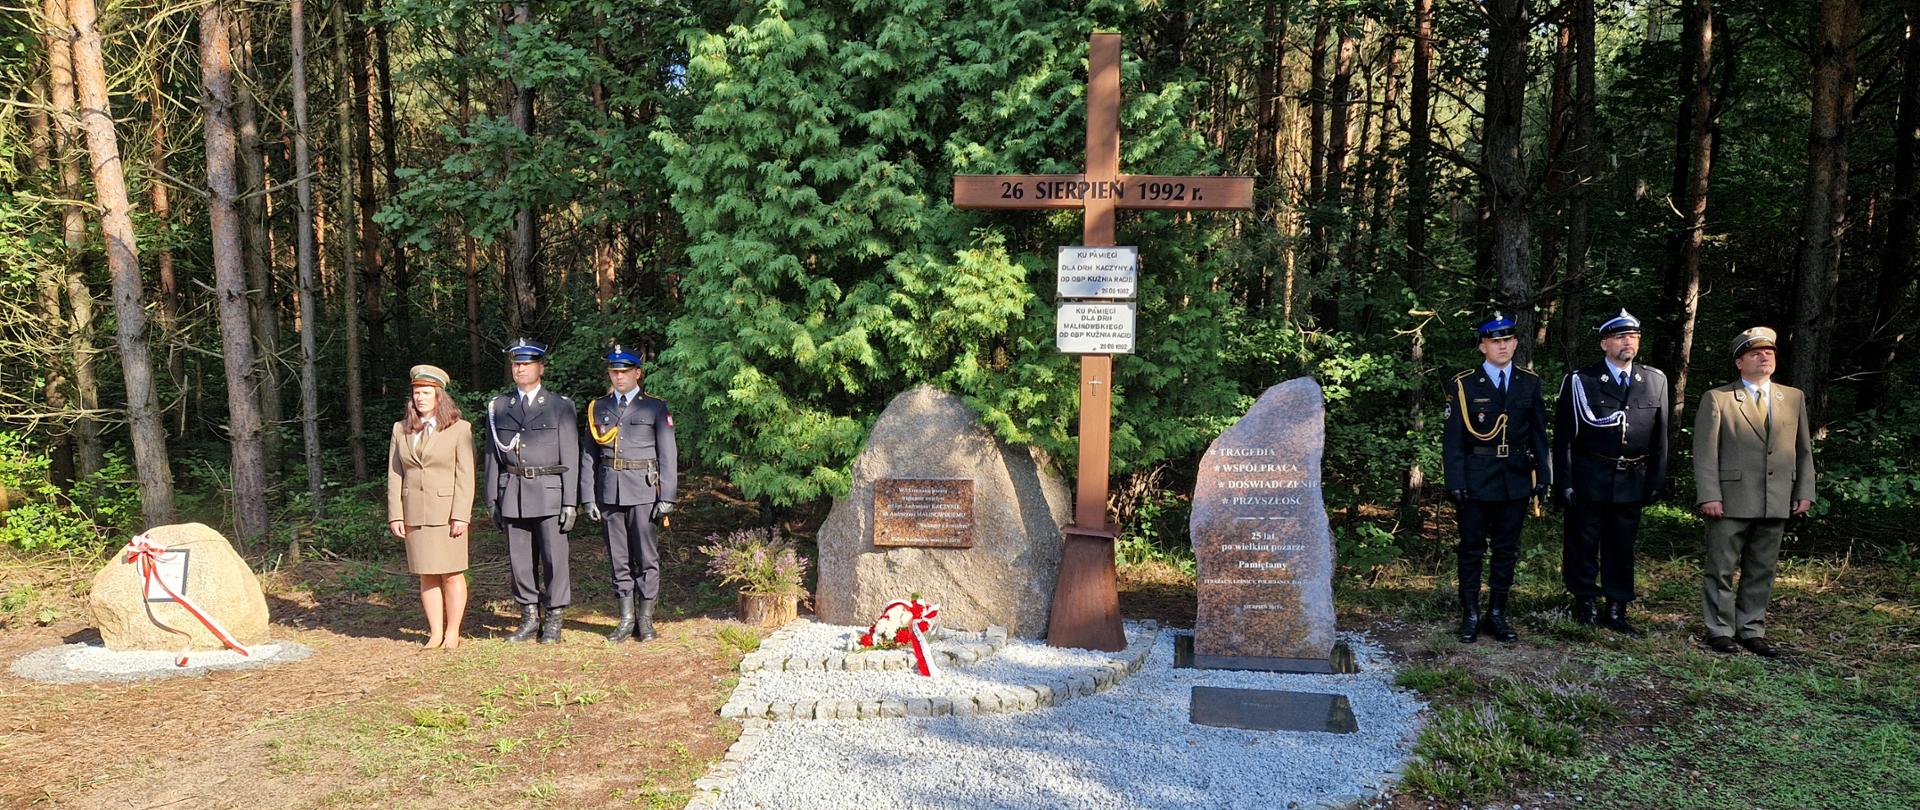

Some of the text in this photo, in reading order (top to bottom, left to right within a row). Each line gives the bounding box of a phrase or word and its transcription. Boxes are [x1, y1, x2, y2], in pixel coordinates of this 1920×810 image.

[1001, 180, 1203, 201] 26 SIERPIEŃ 1992 r.
[1219, 448, 1276, 457] TRAGEDIA
[1222, 462, 1299, 473] WSPÓŁPRACA
[1232, 495, 1303, 506] PRZYSZŁOŚĆ
[1251, 532, 1275, 540] 25 lat
[1221, 543, 1232, 552] po
[1235, 542, 1269, 551] wielkim
[1238, 560, 1287, 571] Pamiętamy
